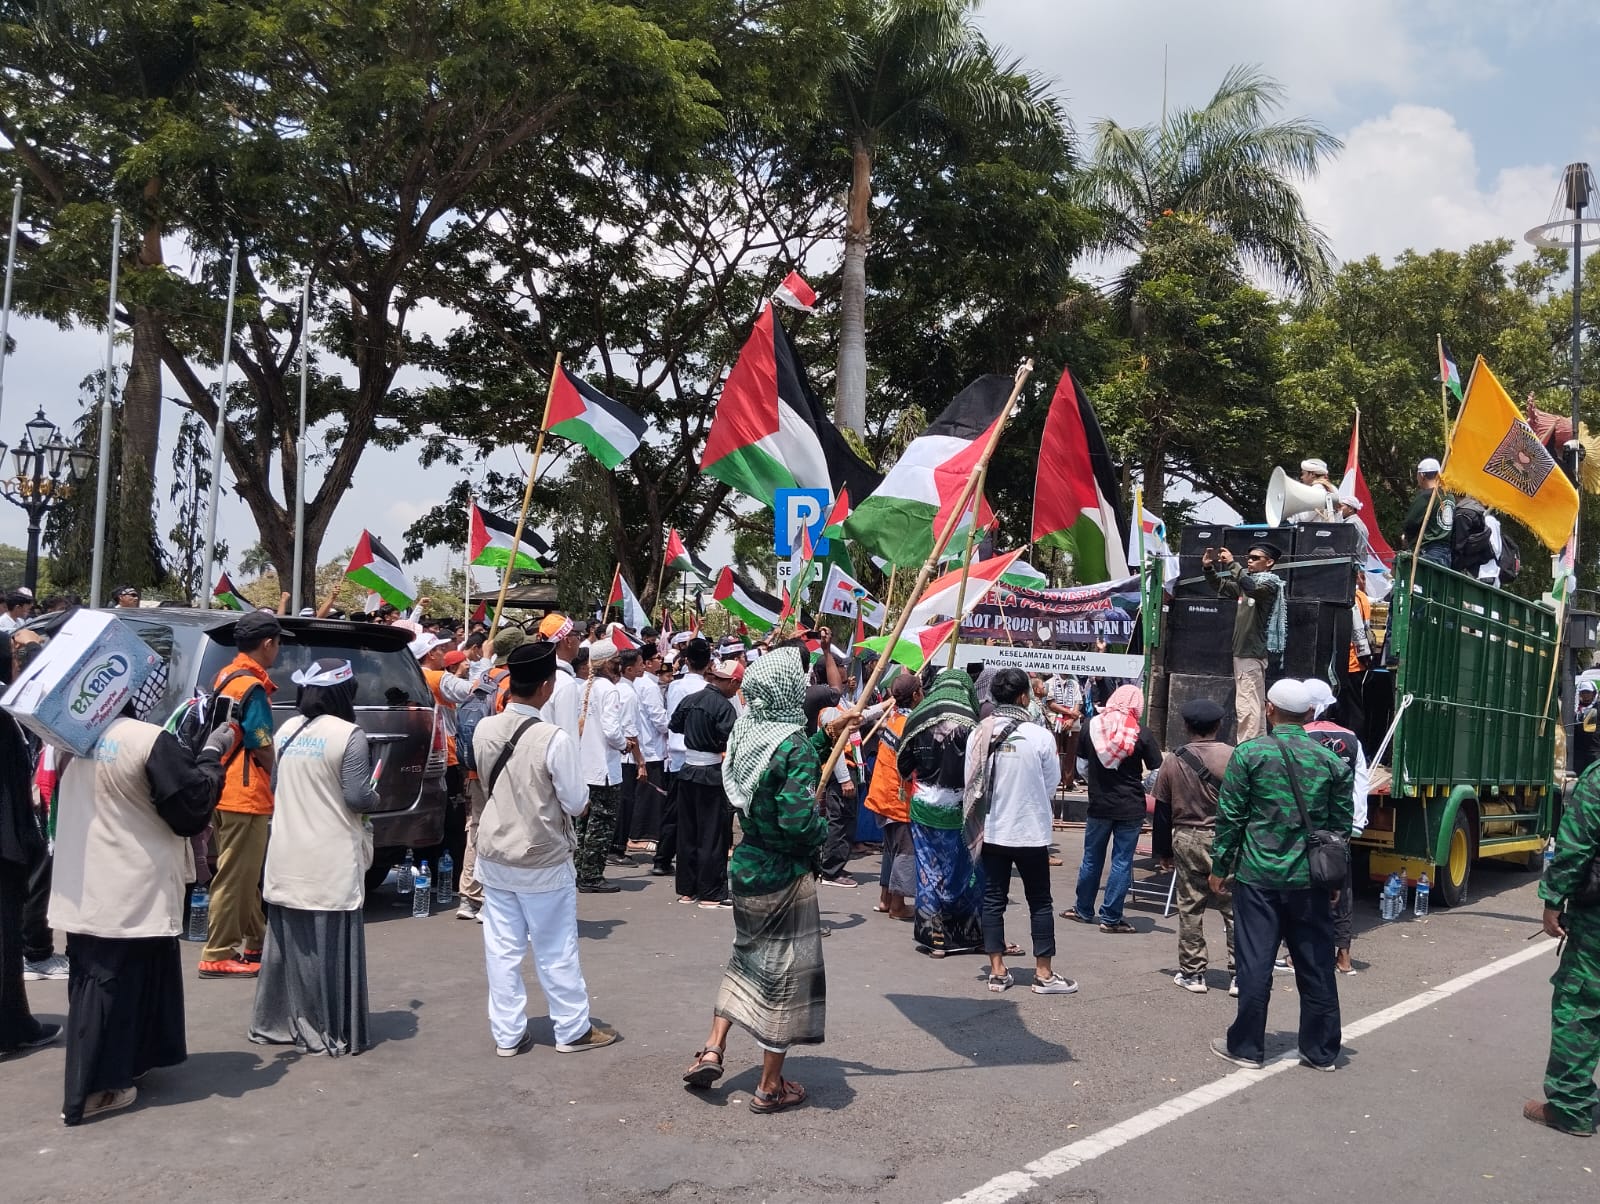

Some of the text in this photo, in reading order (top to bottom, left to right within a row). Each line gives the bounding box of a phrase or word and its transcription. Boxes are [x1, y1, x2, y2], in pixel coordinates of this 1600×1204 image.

[788, 496, 821, 546] P
[1020, 597, 1114, 614] PALESTINA
[1000, 649, 1053, 661] KESELAMATAN
[981, 658, 1107, 673] TANGGUNG JAWAB KITA BERSAMA
